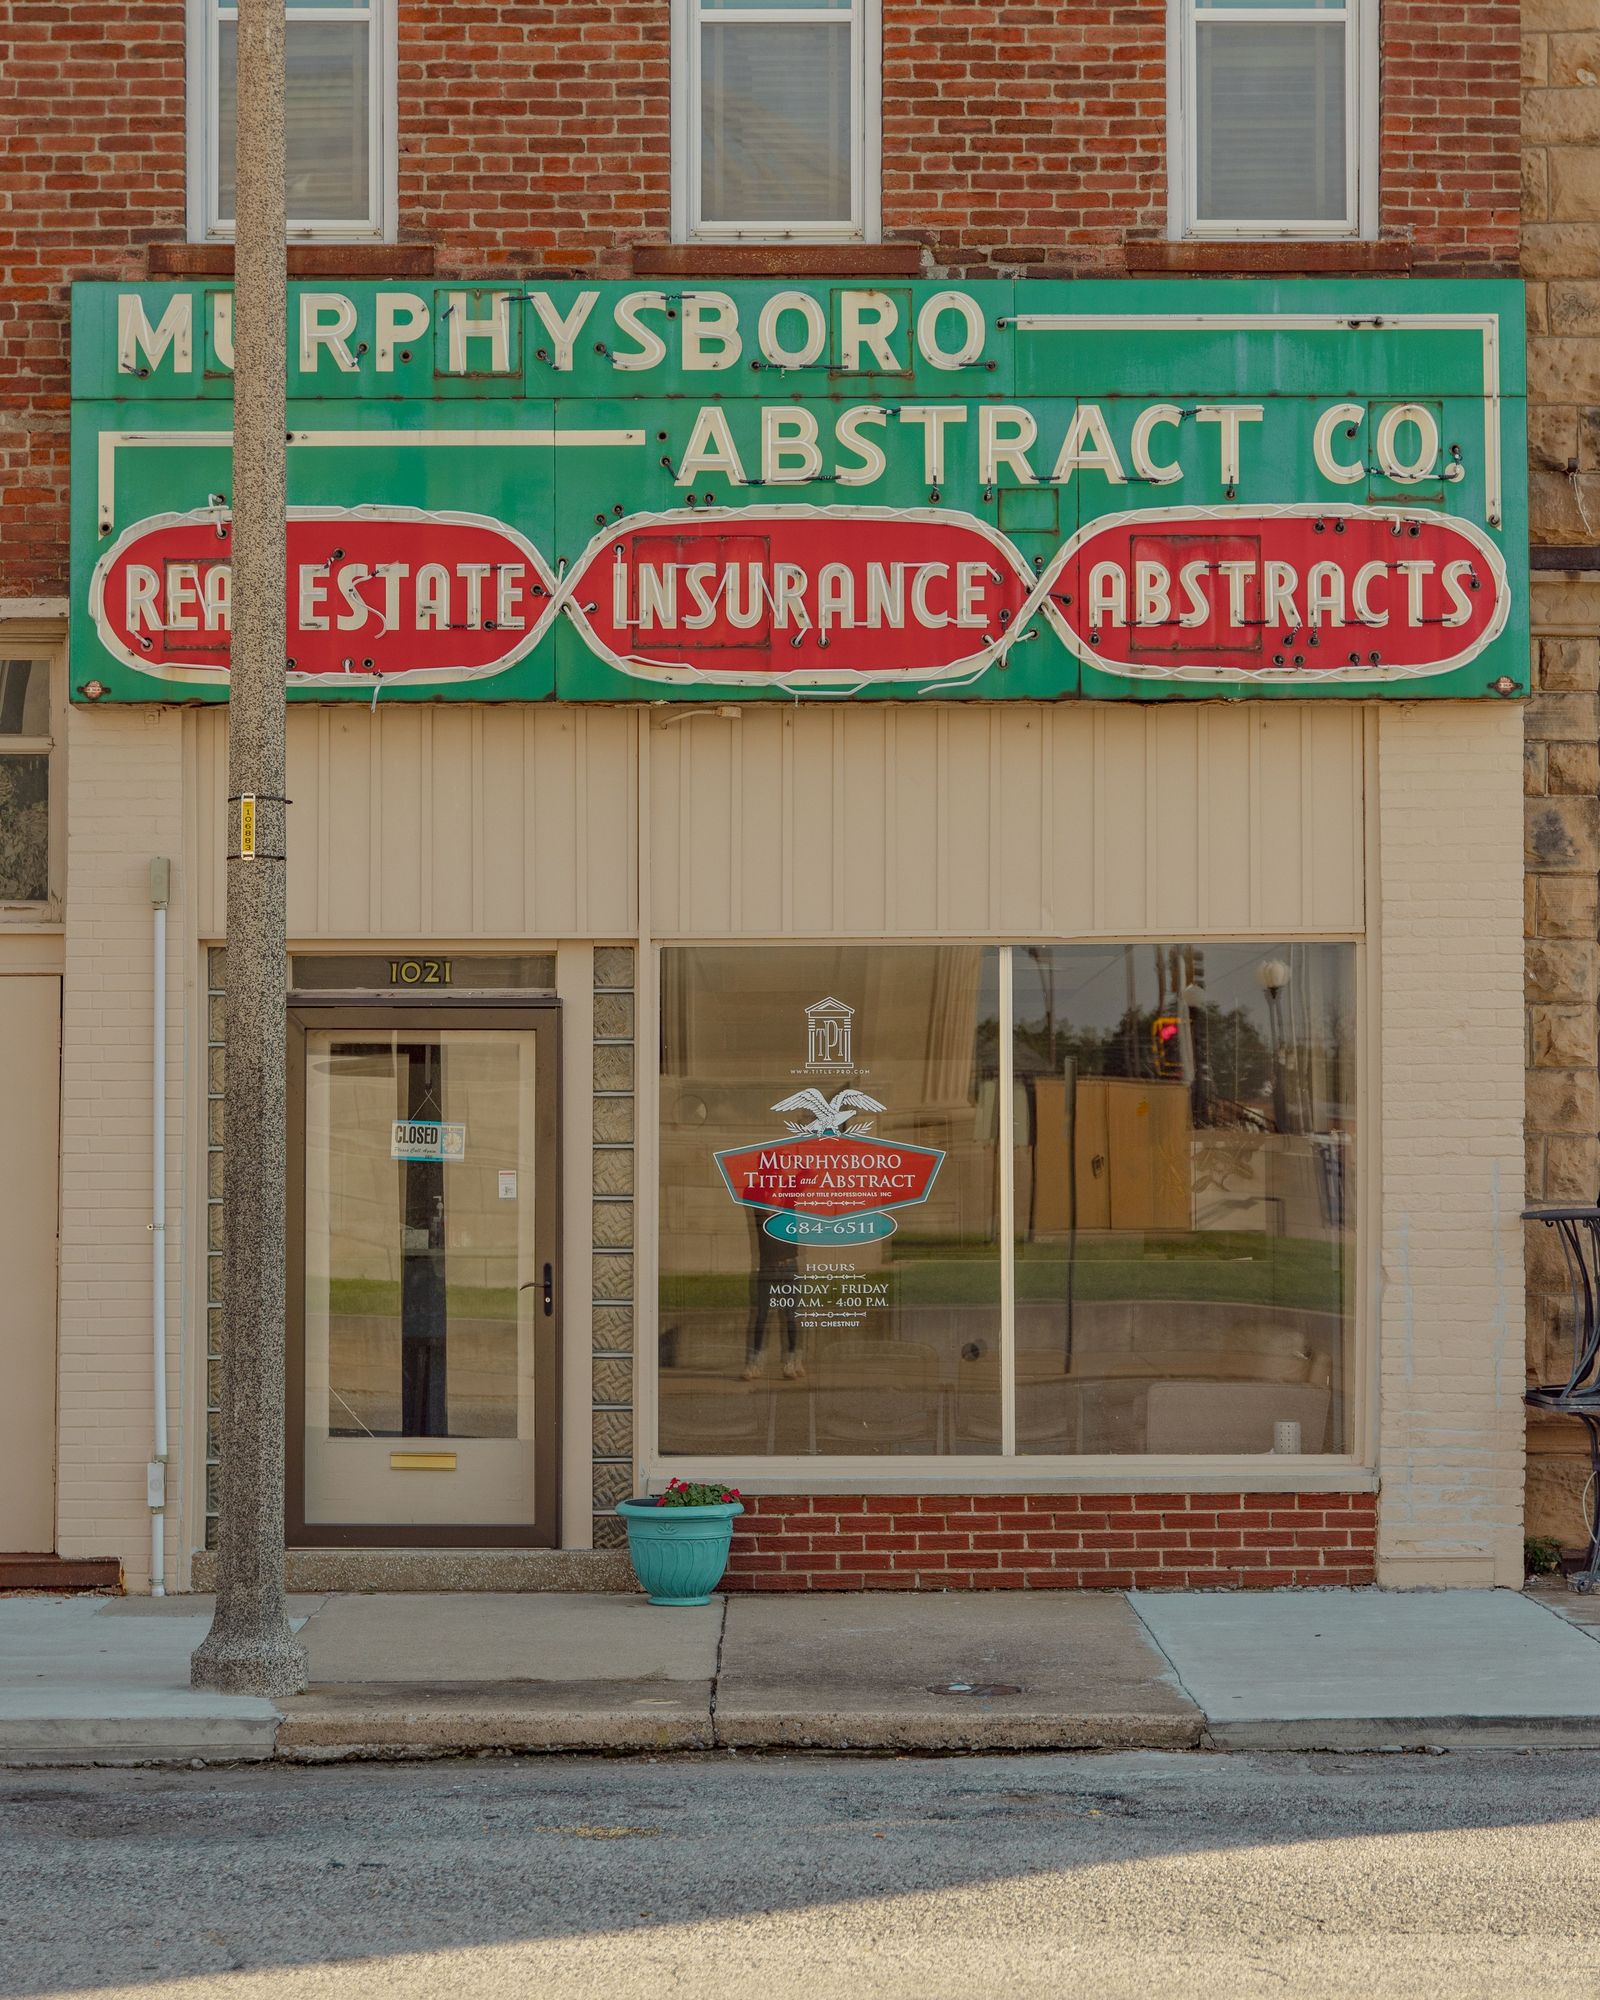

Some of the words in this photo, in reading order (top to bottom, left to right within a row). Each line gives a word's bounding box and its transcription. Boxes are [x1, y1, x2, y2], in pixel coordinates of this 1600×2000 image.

[673, 404, 1264, 486] ABSTRACT
[1312, 404, 1466, 485] CO.
[126, 564, 232, 631] REA
[299, 563, 525, 631] ESTATE
[612, 562, 990, 629] INSURANCE
[1088, 561, 1473, 628] ABSTRACTS
[244, 809, 252, 851] 106883
[390, 961, 452, 983] 1021
[816, 1020, 843, 1060] TPI
[395, 1125, 438, 1145] CLOSED
[758, 1151, 902, 1170] MURPHYSBORO
[744, 1171, 797, 1188] TITLE
[800, 1175, 817, 1185] and
[821, 1171, 916, 1188] ABSTRACT
[785, 1221, 875, 1234] 684-6511
[805, 1263, 855, 1272] HOURS
[769, 1284, 830, 1294] MONDAY
[841, 1283, 889, 1294] FRIDAY
[769, 1297, 795, 1307] 8:00
[797, 1297, 824, 1307] A.M.
[836, 1297, 862, 1307] 4:00
[866, 1297, 889, 1307] P.M.
